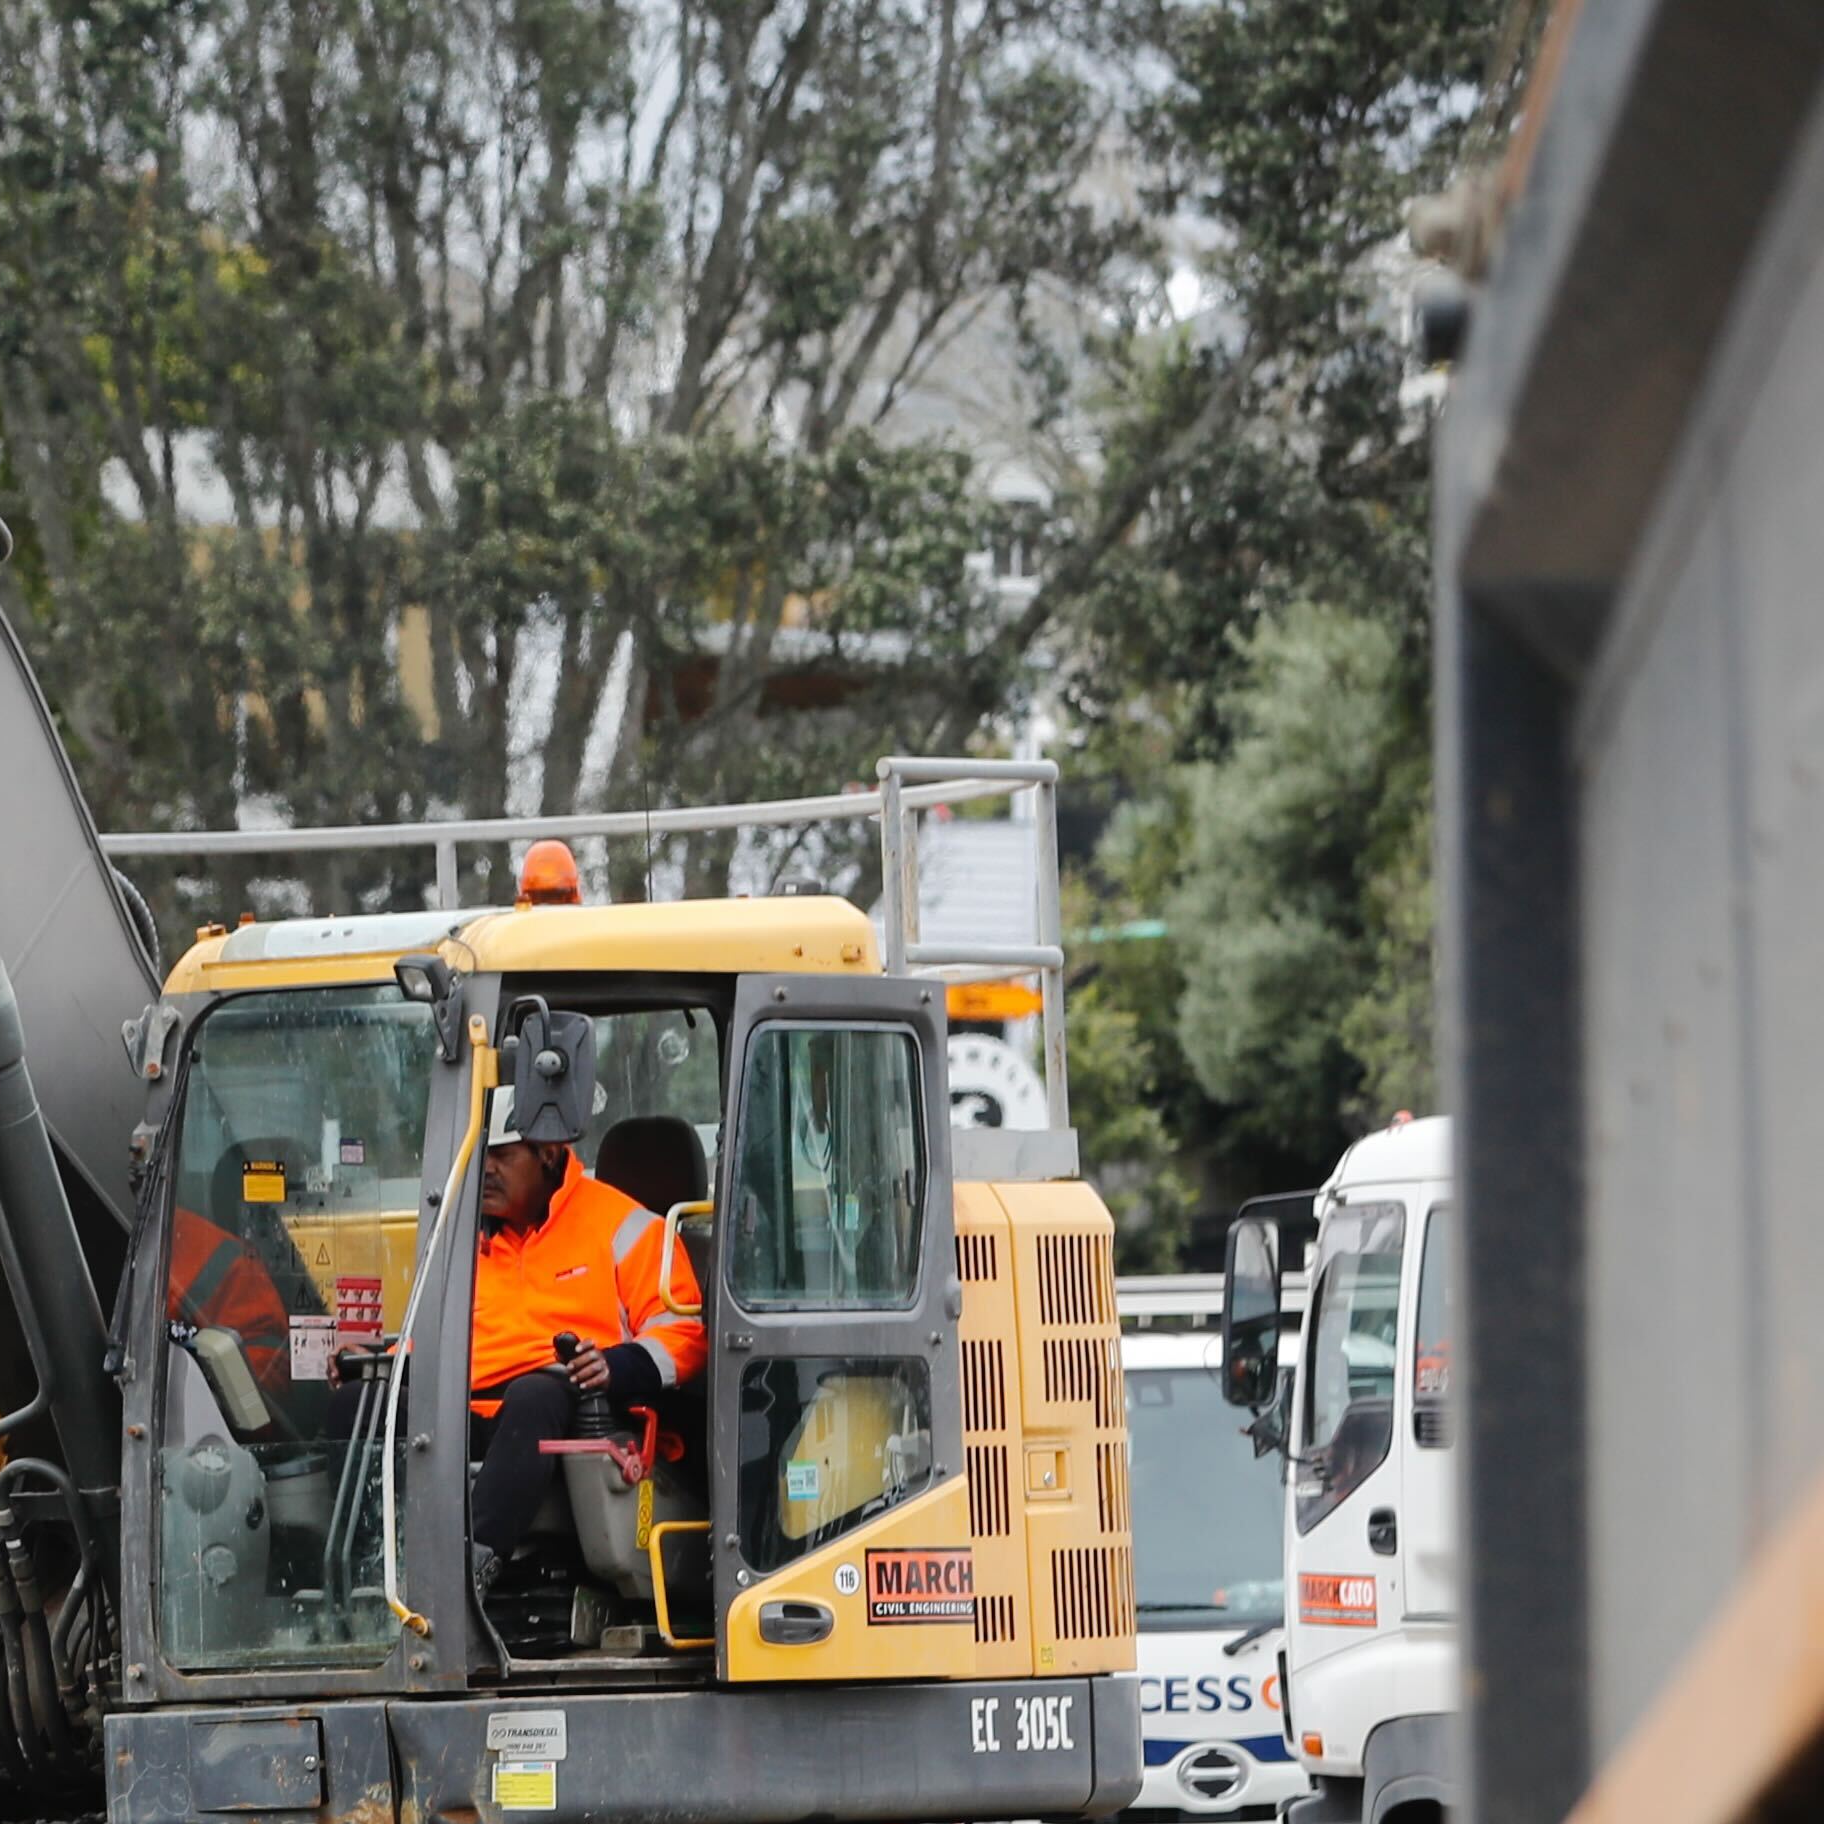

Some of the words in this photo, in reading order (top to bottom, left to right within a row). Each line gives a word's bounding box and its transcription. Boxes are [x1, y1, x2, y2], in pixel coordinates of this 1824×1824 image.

[839, 1571, 855, 1589] 116
[875, 1560, 974, 1595] MARCH
[875, 1602, 906, 1616] CIVIL
[909, 1601, 974, 1615] ENGINEERING
[971, 1697, 1001, 1753] EC
[1014, 1695, 1075, 1752] 305C
